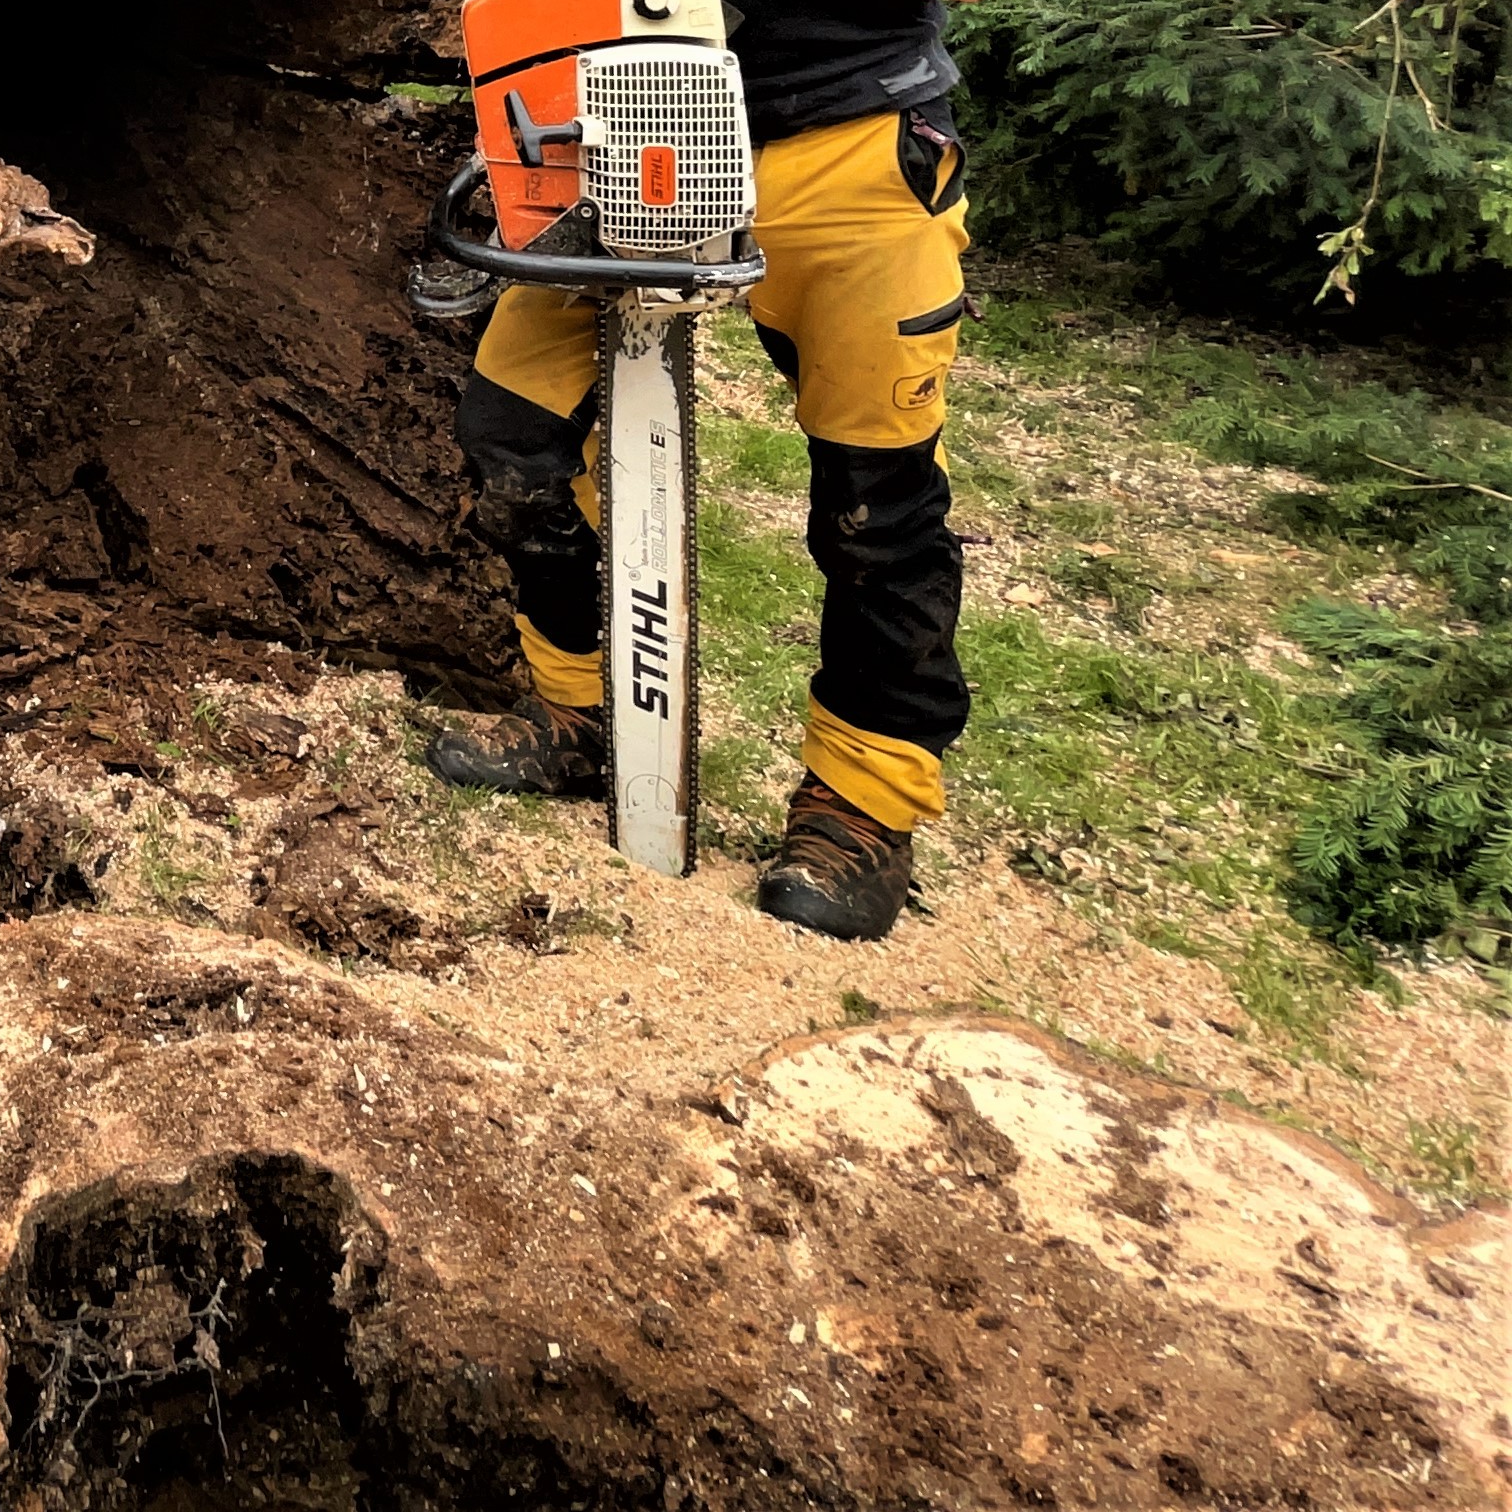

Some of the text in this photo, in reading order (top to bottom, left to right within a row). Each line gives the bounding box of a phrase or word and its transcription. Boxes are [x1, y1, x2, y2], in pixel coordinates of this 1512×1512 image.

[651, 154, 663, 199] STIHL
[649, 419, 668, 574] ROLLOMATIC ES
[632, 579, 668, 720] STIHL
